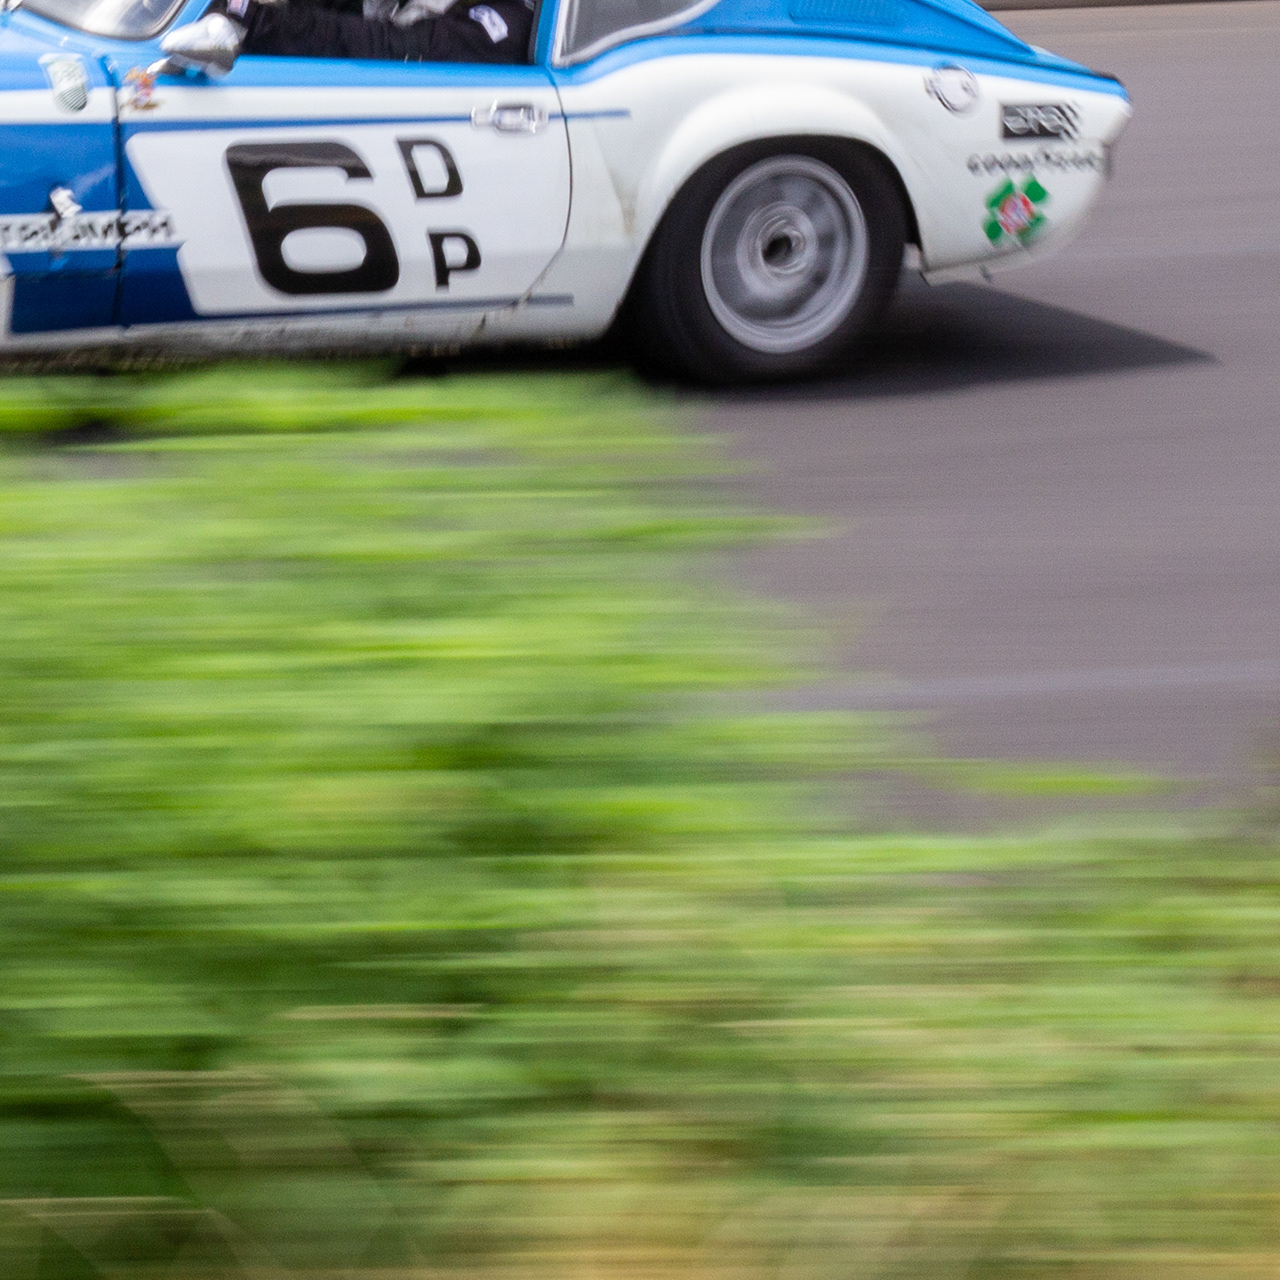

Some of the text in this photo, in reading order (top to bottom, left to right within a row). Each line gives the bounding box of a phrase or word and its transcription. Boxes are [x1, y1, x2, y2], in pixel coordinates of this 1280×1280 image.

[395, 137, 464, 200] D
[225, 141, 400, 296] 6
[426, 230, 483, 292] P
